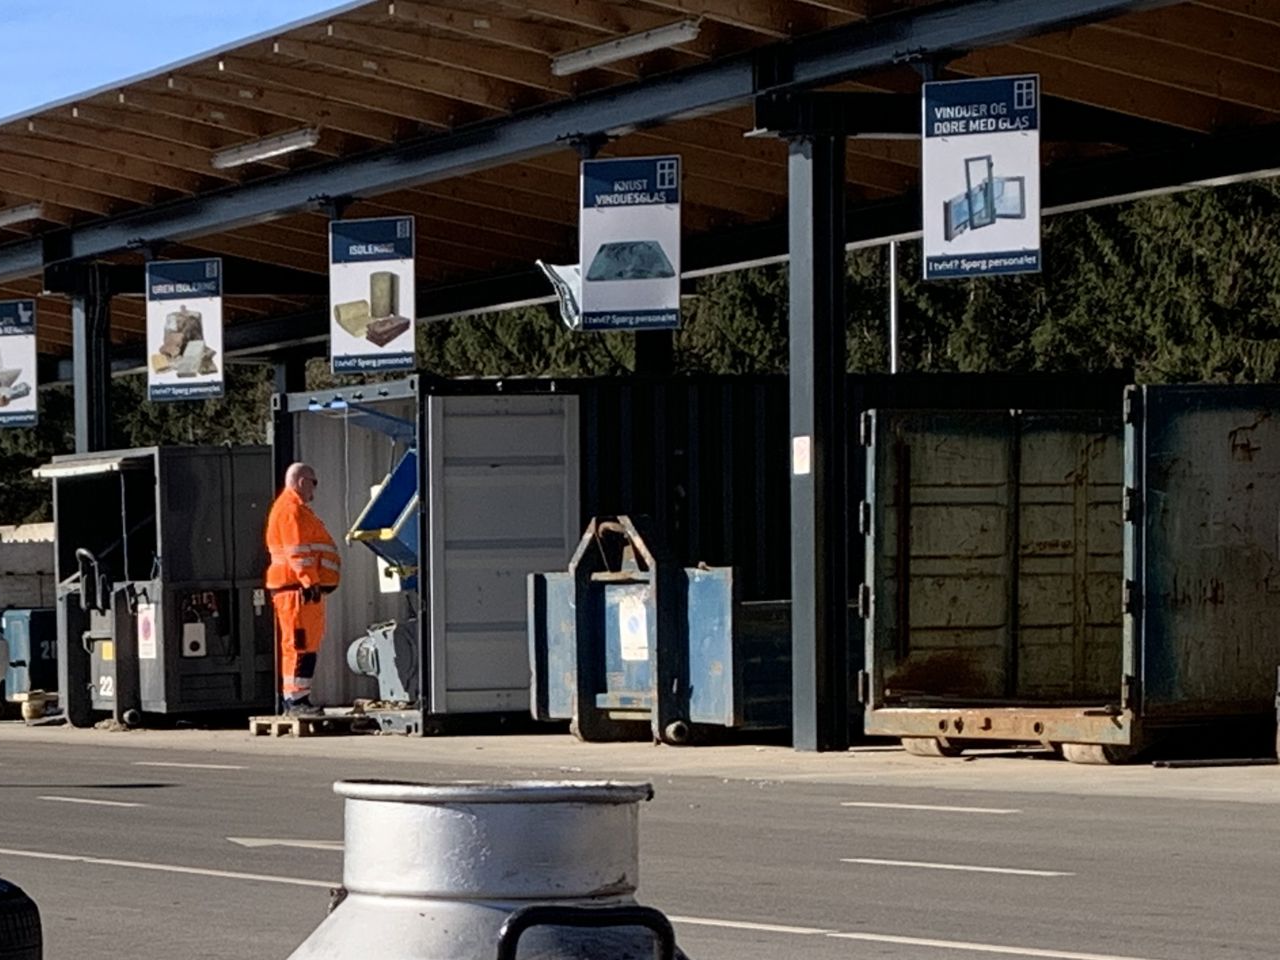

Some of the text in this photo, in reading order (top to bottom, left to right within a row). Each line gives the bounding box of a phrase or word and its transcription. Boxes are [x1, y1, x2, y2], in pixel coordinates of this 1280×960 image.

[934, 102, 1007, 119] VINDUER OG
[969, 118, 996, 132] MED
[998, 115, 1030, 130] GLAS
[99, 675, 113, 696] 22
